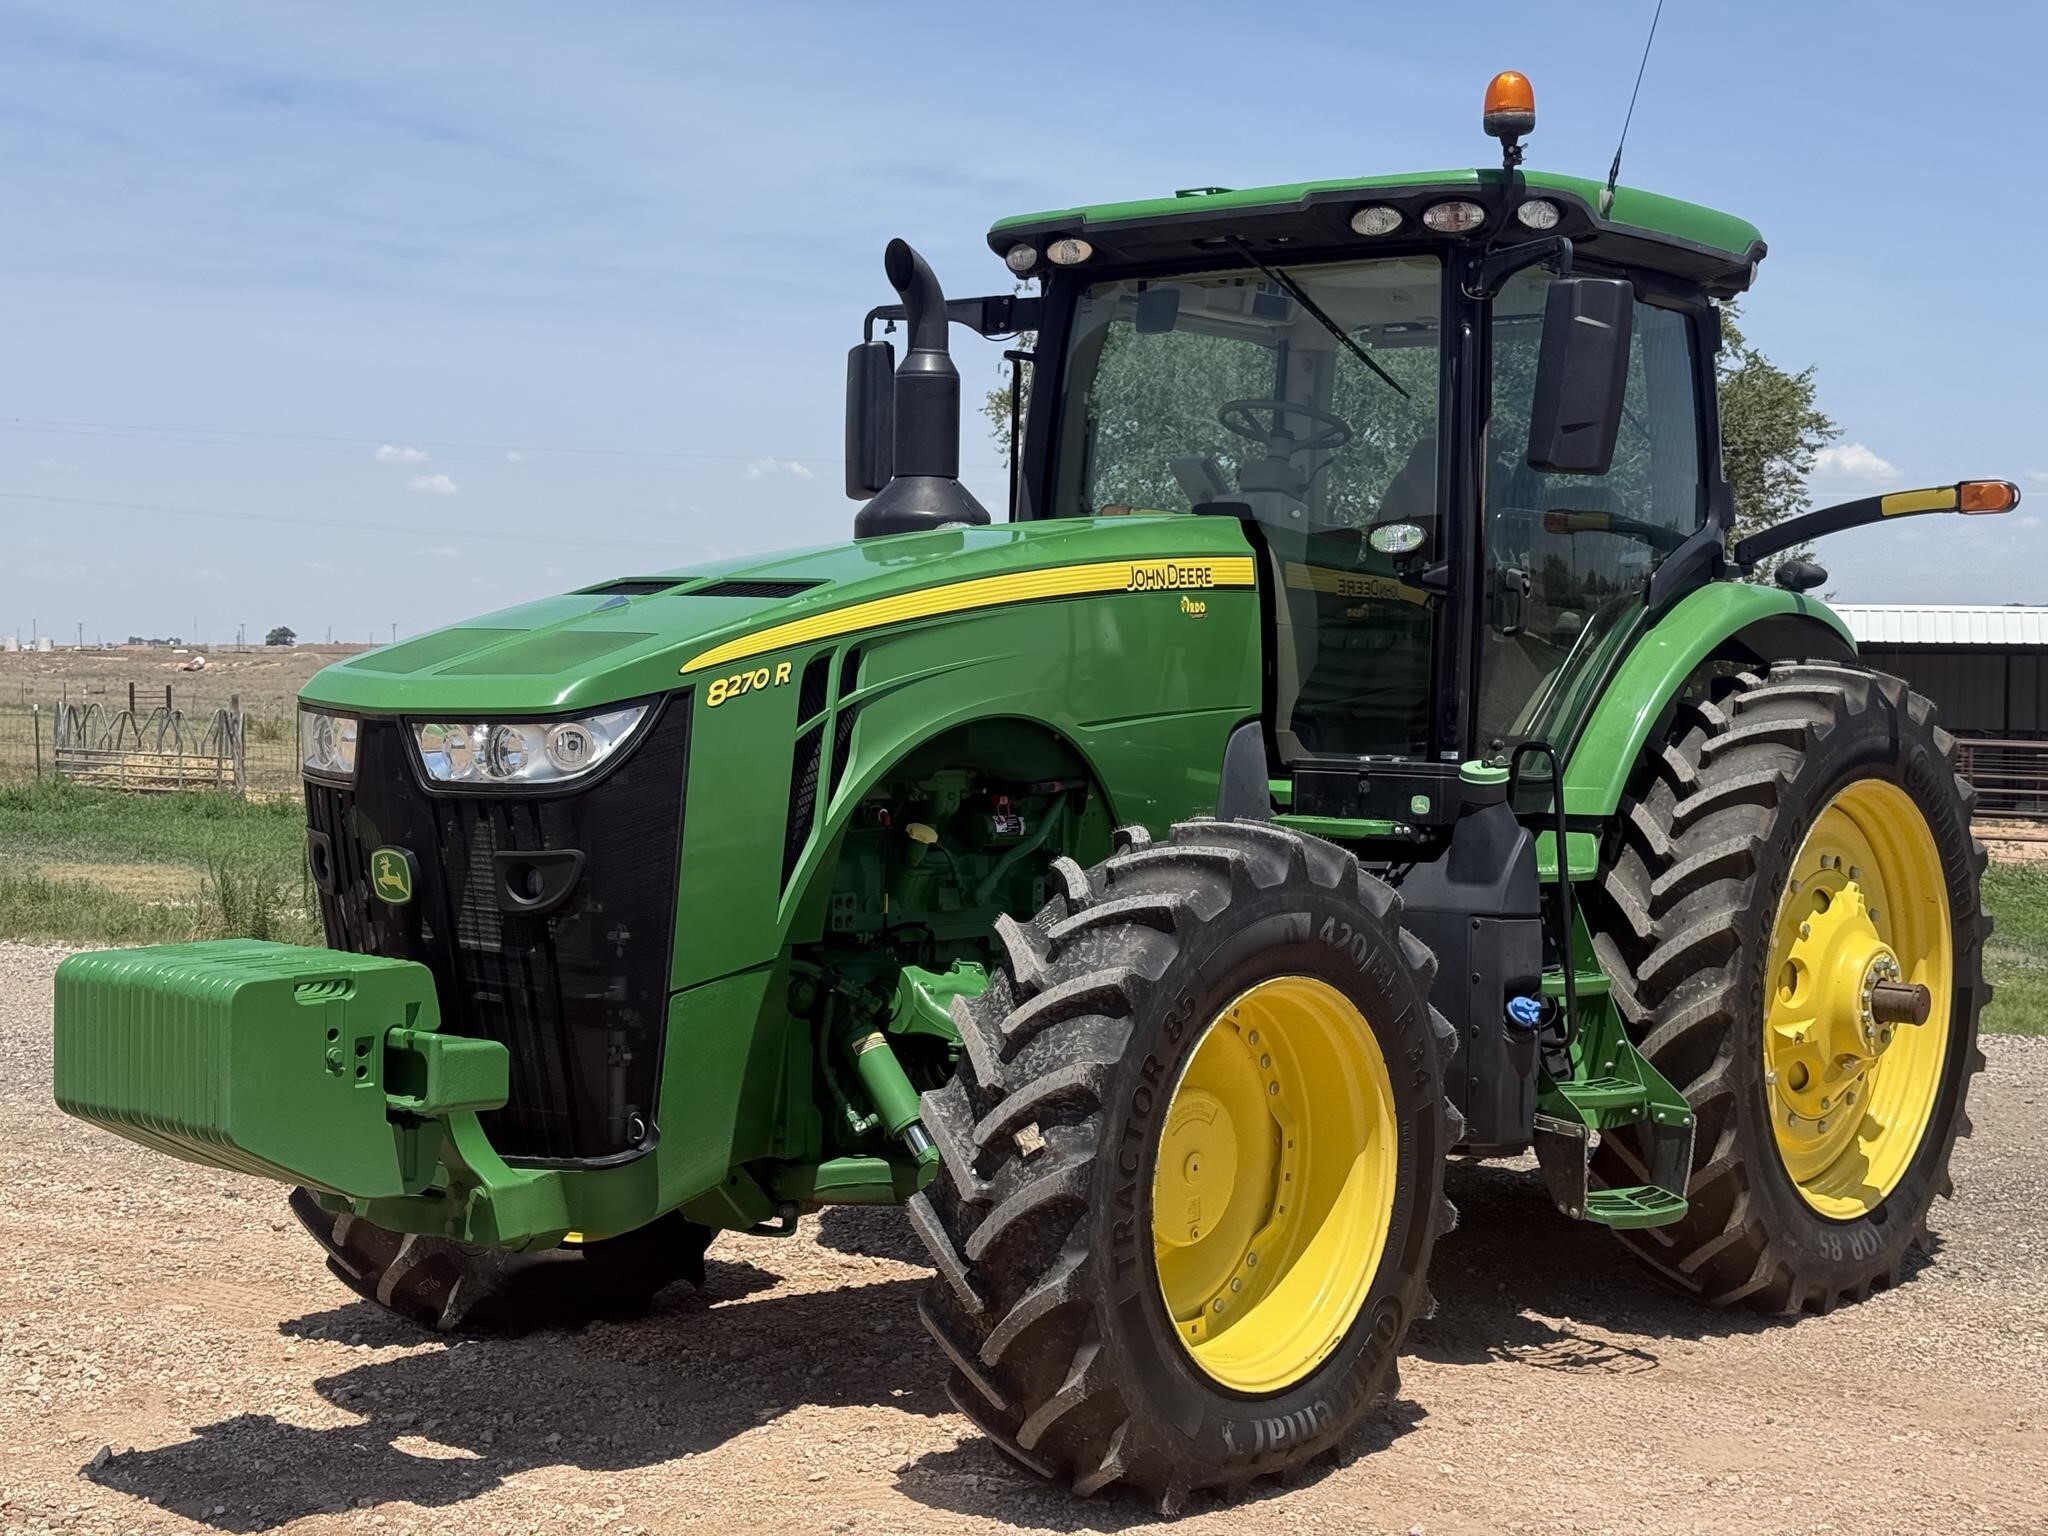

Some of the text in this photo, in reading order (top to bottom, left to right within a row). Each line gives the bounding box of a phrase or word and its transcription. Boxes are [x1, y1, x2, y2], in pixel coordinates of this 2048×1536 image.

[1127, 563, 1214, 590] JOHN DEERE
[706, 661, 792, 707] 8270 R
[1112, 985, 1197, 1282] TRACTOR 85
